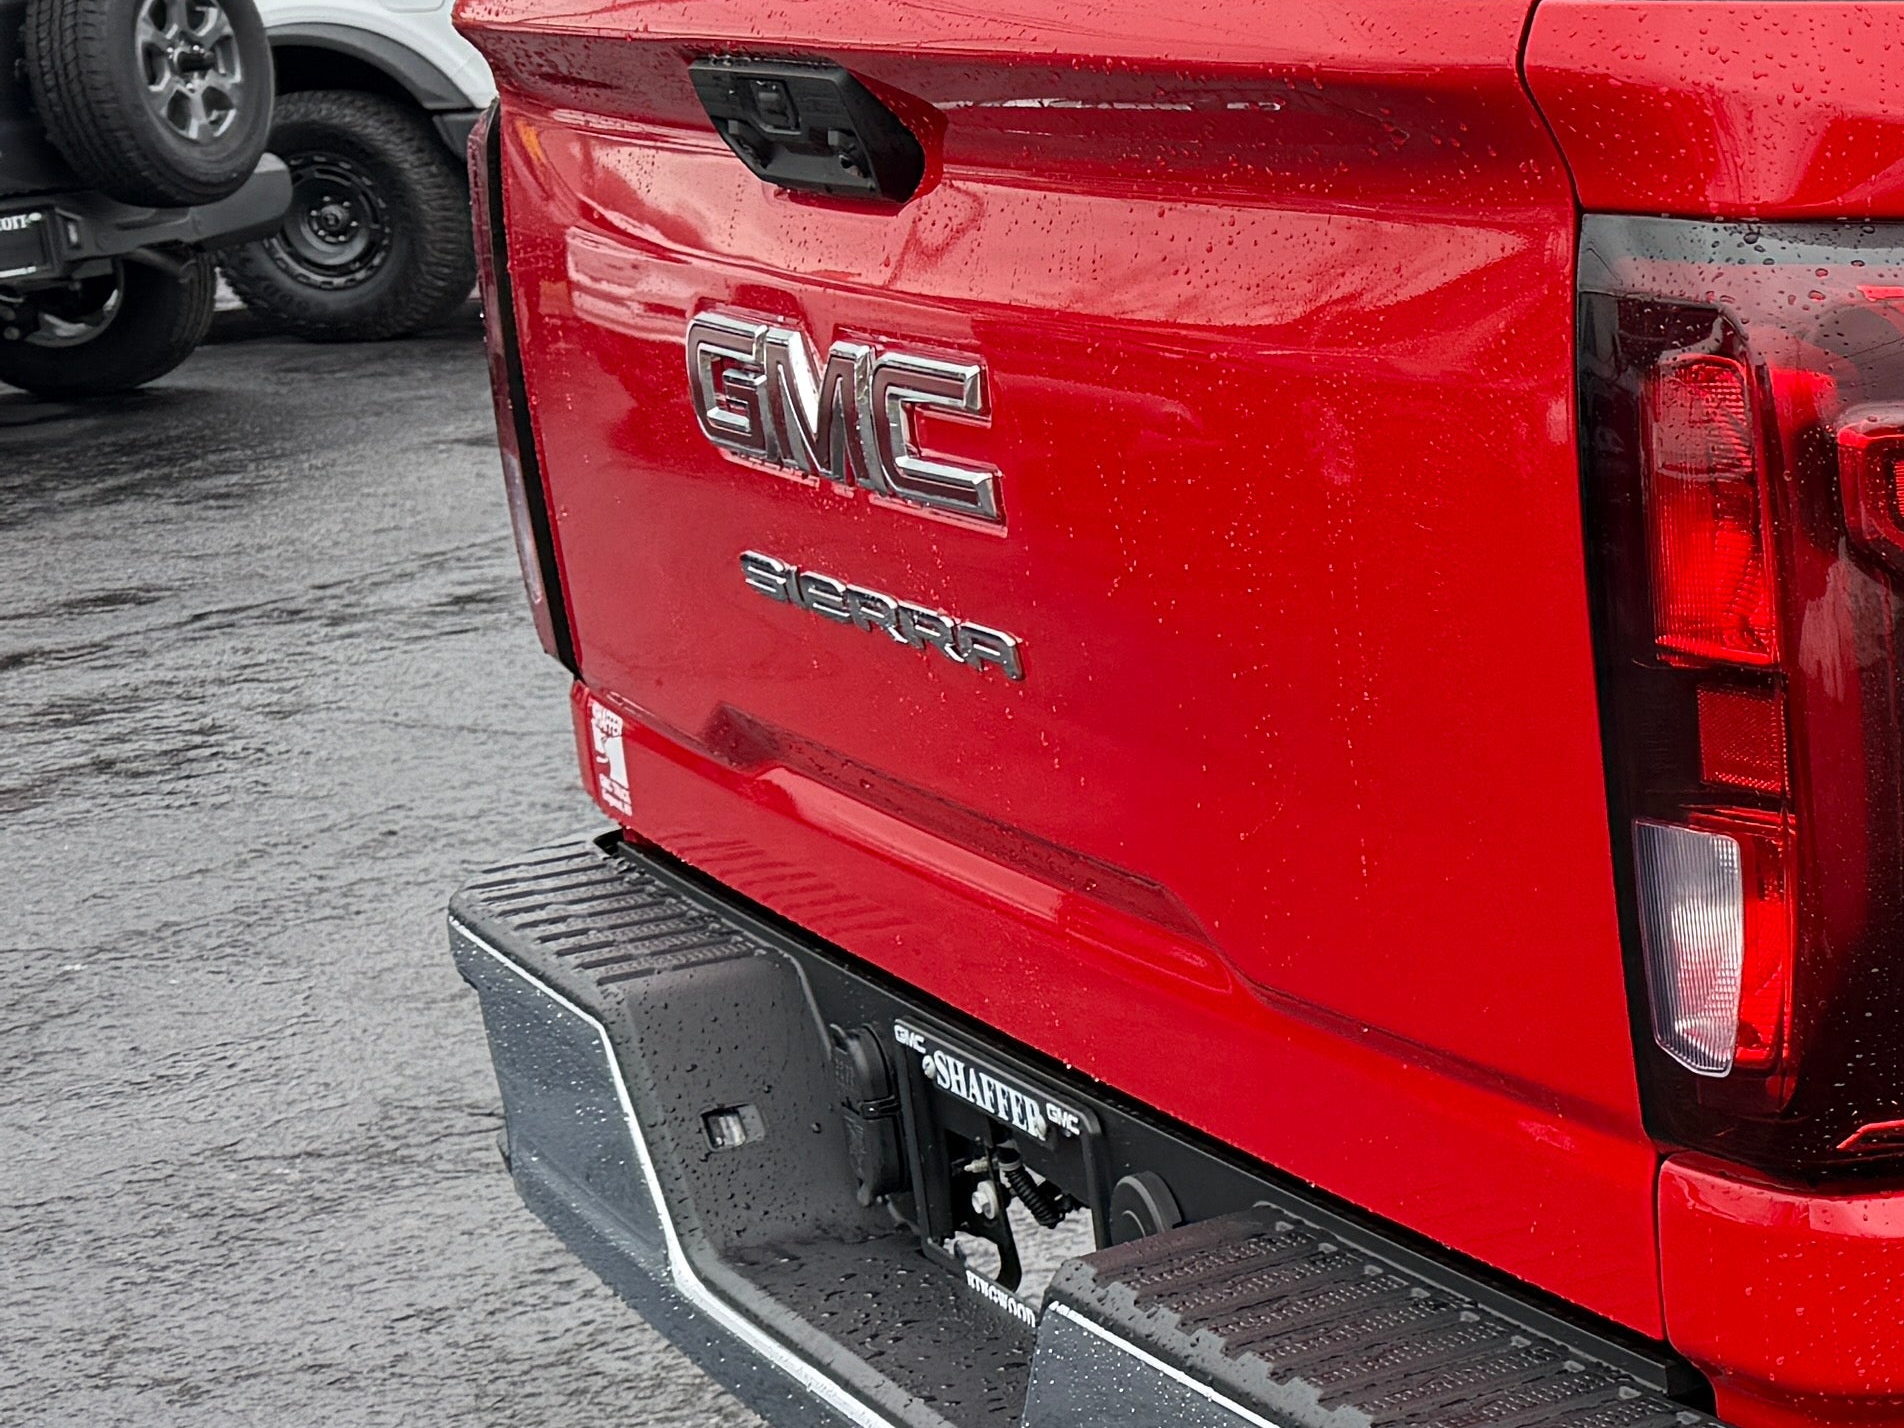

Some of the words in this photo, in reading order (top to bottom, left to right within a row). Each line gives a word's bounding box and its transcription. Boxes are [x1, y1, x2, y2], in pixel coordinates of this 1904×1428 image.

[0, 214, 27, 232] OTT
[685, 308, 1008, 532] GMC
[739, 549, 1026, 682] SIERRA
[893, 1024, 926, 1055] GMC
[932, 1049, 1047, 1141] SHAFFER
[1045, 1102, 1080, 1136] GMC
